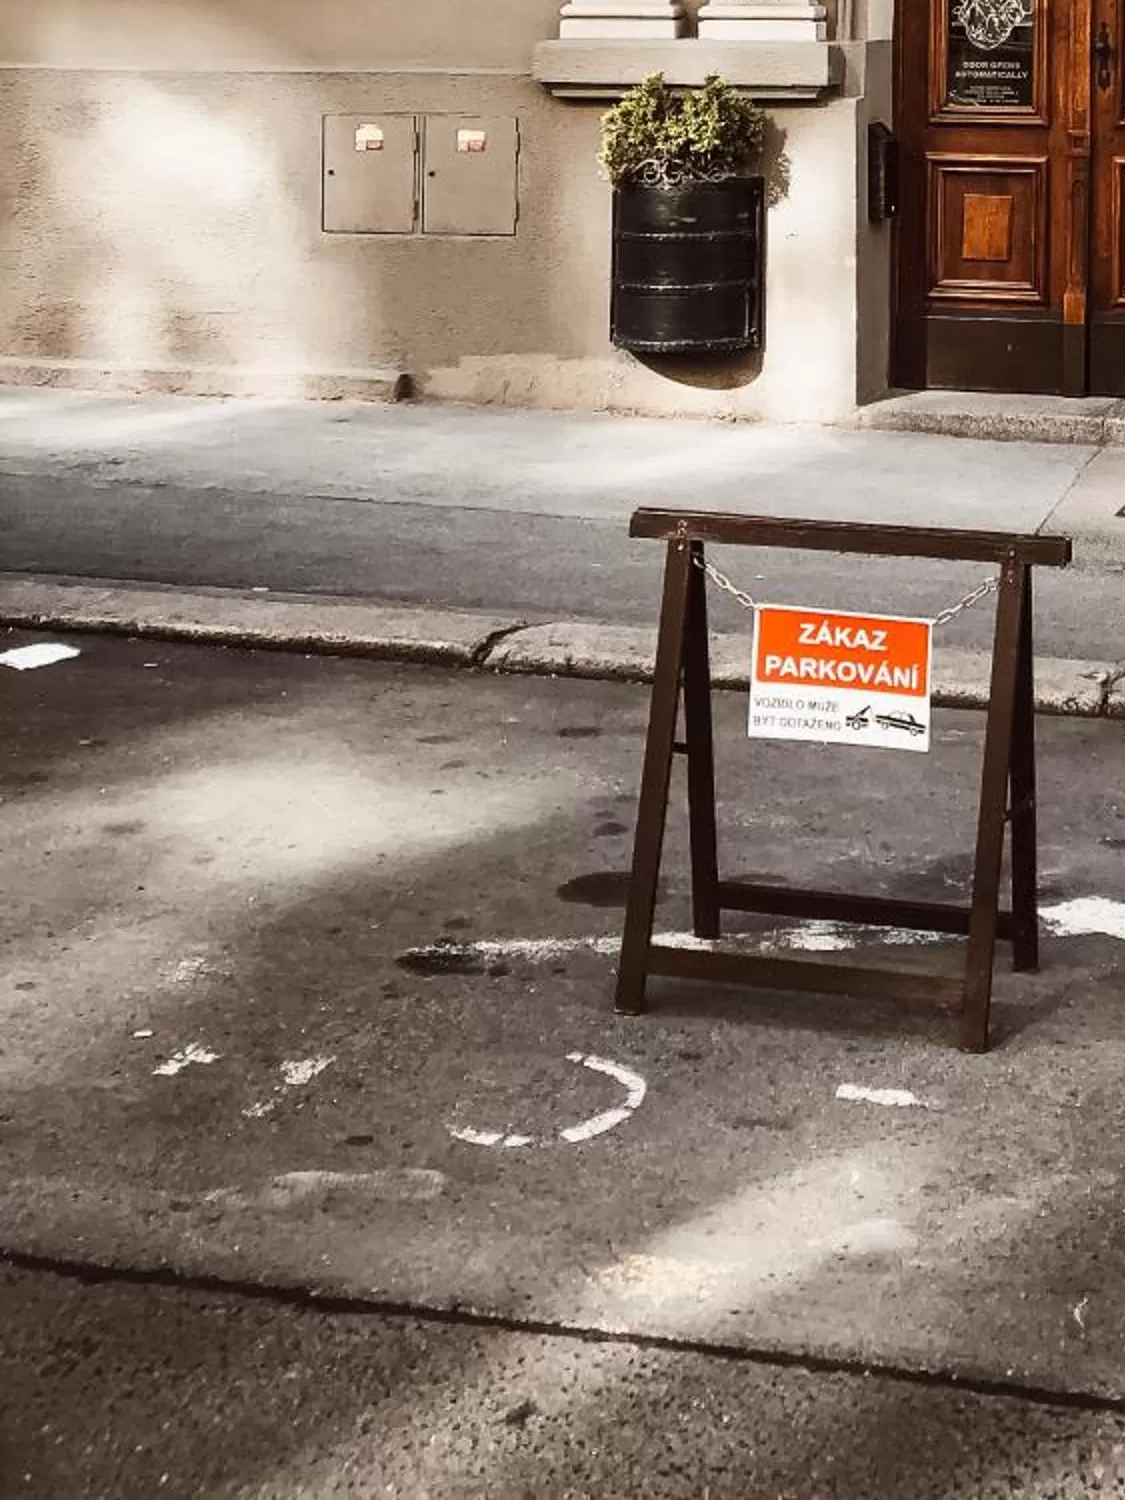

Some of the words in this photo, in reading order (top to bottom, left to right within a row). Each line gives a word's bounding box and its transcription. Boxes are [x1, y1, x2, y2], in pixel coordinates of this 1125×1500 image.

[955, 70, 1029, 79] AUTOMATICALLY
[799, 620, 888, 650] ZÁKAZ
[764, 655, 920, 690] PARKOVÁNÍ
